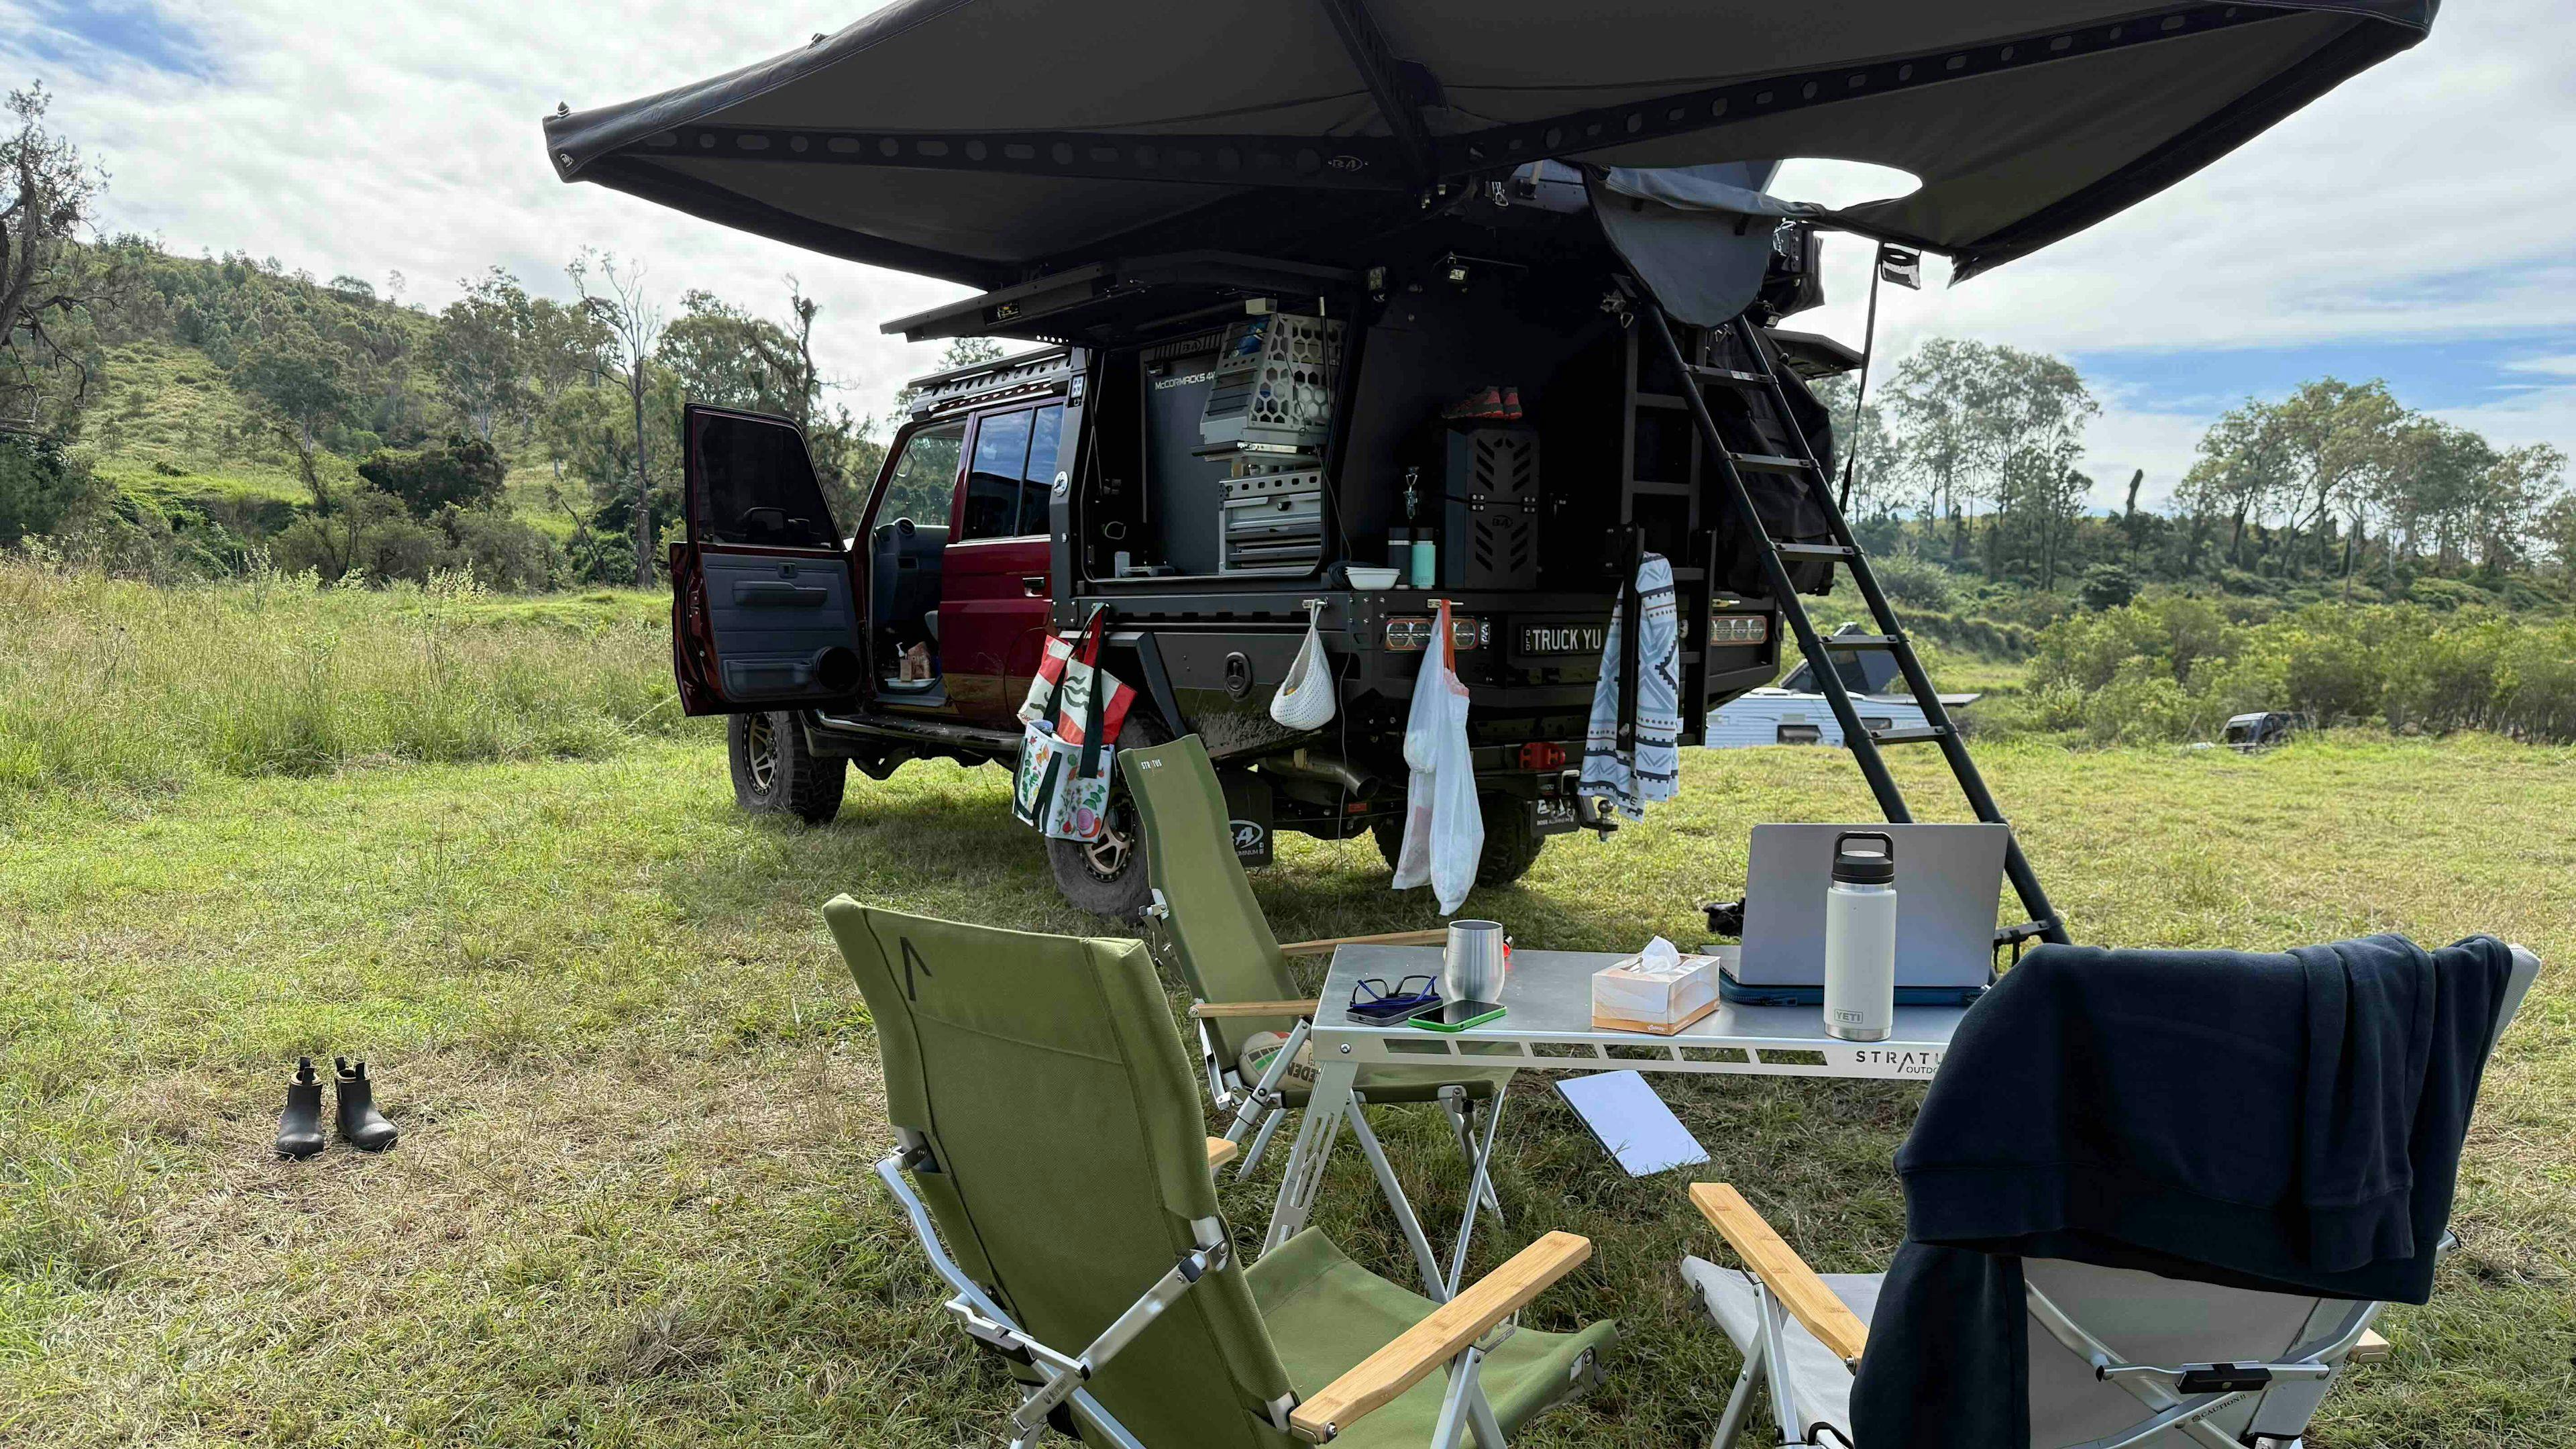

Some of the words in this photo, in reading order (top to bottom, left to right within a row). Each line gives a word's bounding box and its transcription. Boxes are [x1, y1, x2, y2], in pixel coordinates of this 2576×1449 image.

[1532, 629, 1578, 650] TRUCK
[1582, 629, 1601, 649] YU
[1836, 1011, 1861, 1022] YETI
